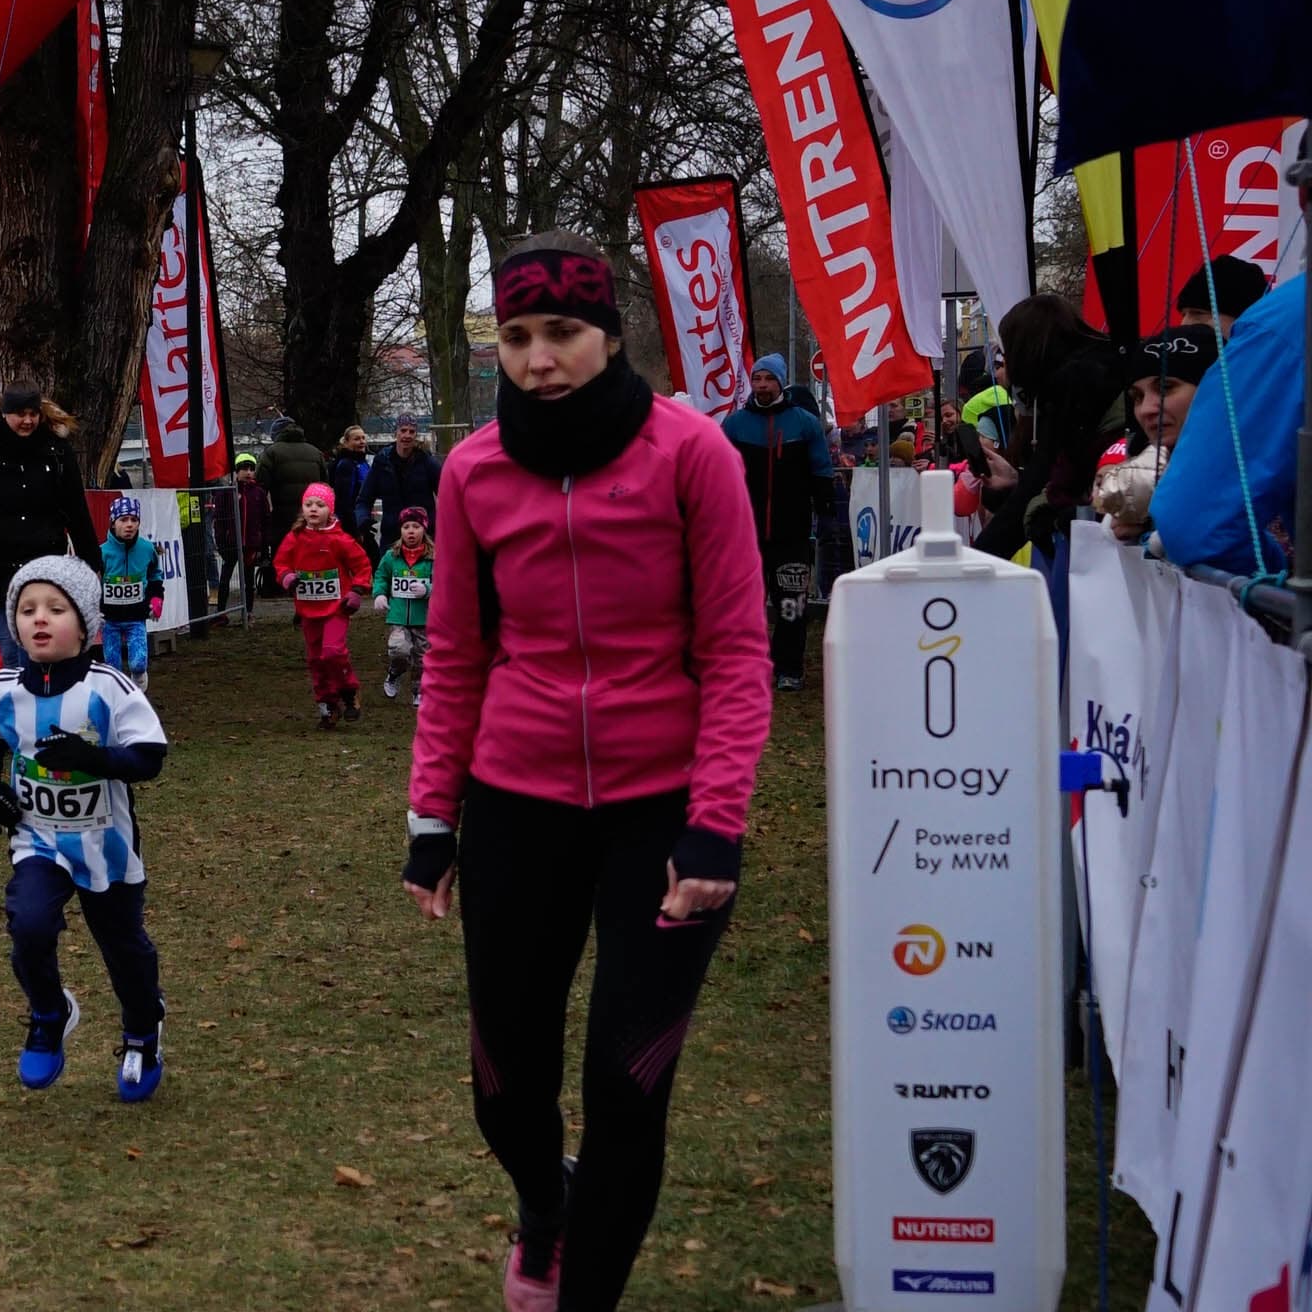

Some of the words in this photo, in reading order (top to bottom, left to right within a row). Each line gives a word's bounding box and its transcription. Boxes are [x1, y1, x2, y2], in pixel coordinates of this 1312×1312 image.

[105, 584, 140, 598] 3083
[297, 580, 336, 594] 3126
[871, 762, 1010, 795] innogy
[19, 779, 101, 818] 3067
[915, 828, 1011, 848] Powered
[915, 852, 943, 874] by
[952, 854, 1010, 870] MVM
[955, 942, 993, 959] NN
[920, 1008, 997, 1032] ŠKODA
[913, 1085, 991, 1099] RUNTO
[898, 1222, 991, 1239] NUTREND
